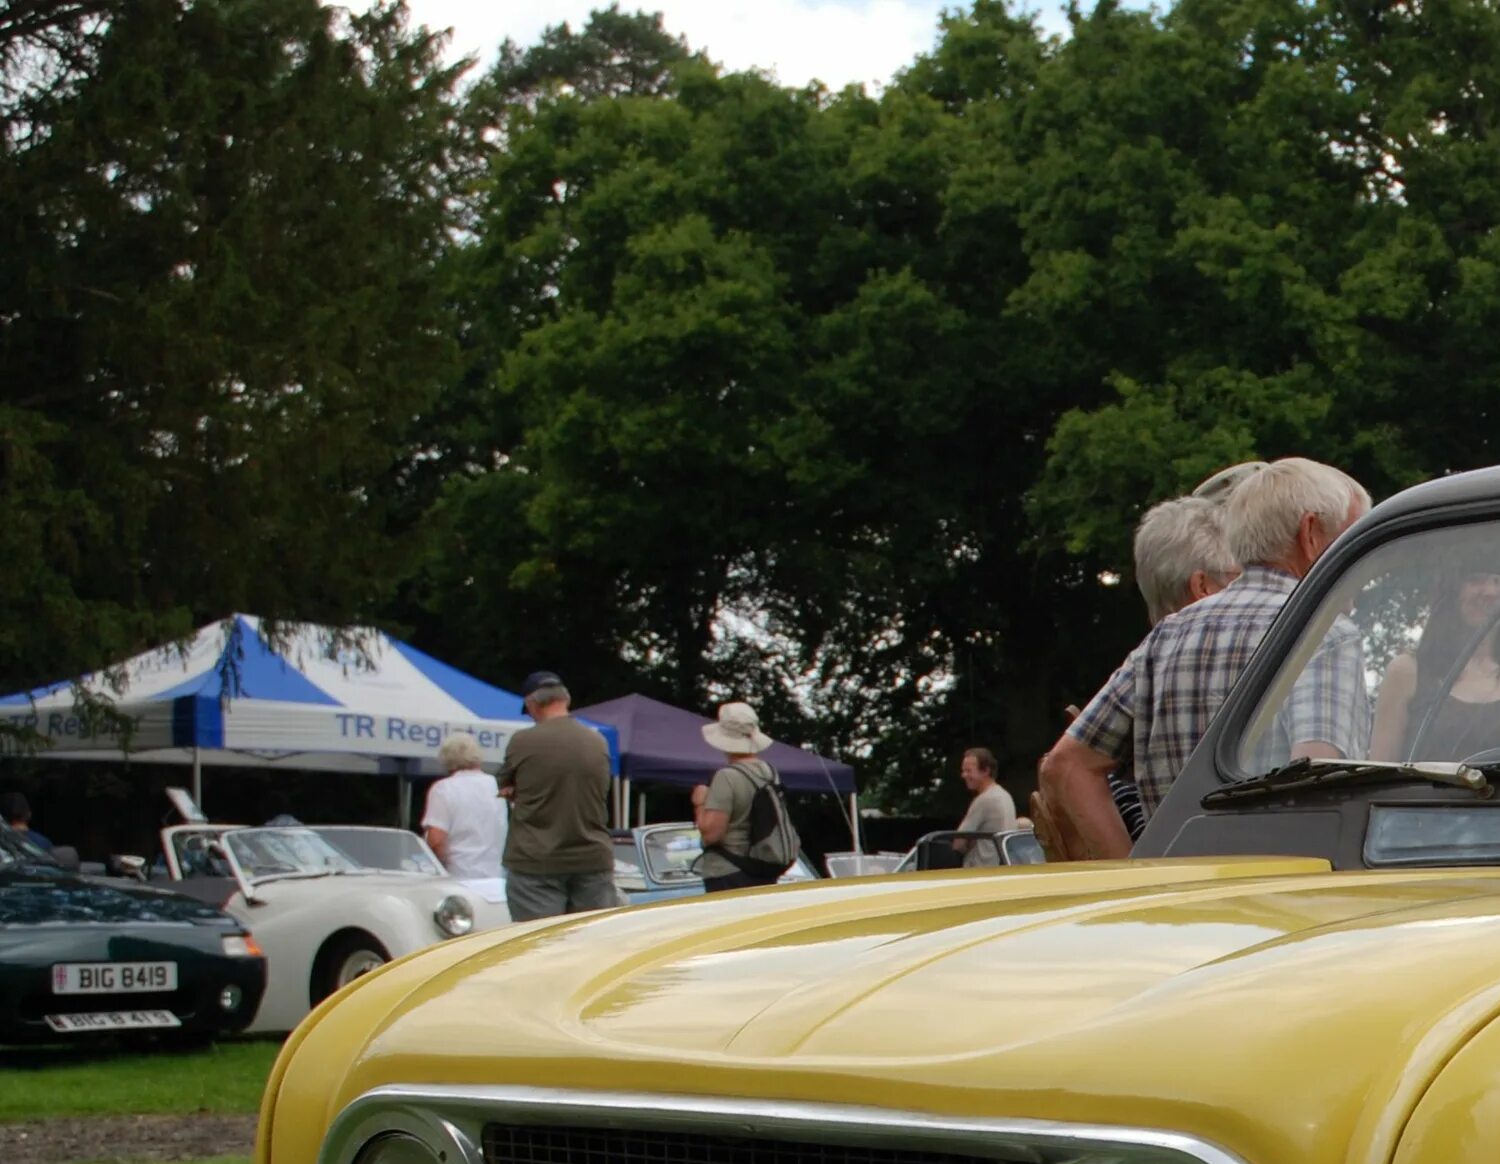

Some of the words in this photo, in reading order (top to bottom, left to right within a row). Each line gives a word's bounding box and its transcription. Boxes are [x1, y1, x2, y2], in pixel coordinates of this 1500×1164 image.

[335, 713, 376, 738] TR
[386, 718, 505, 748] Regier
[79, 968, 114, 989] BIG
[121, 966, 167, 988] 8419
